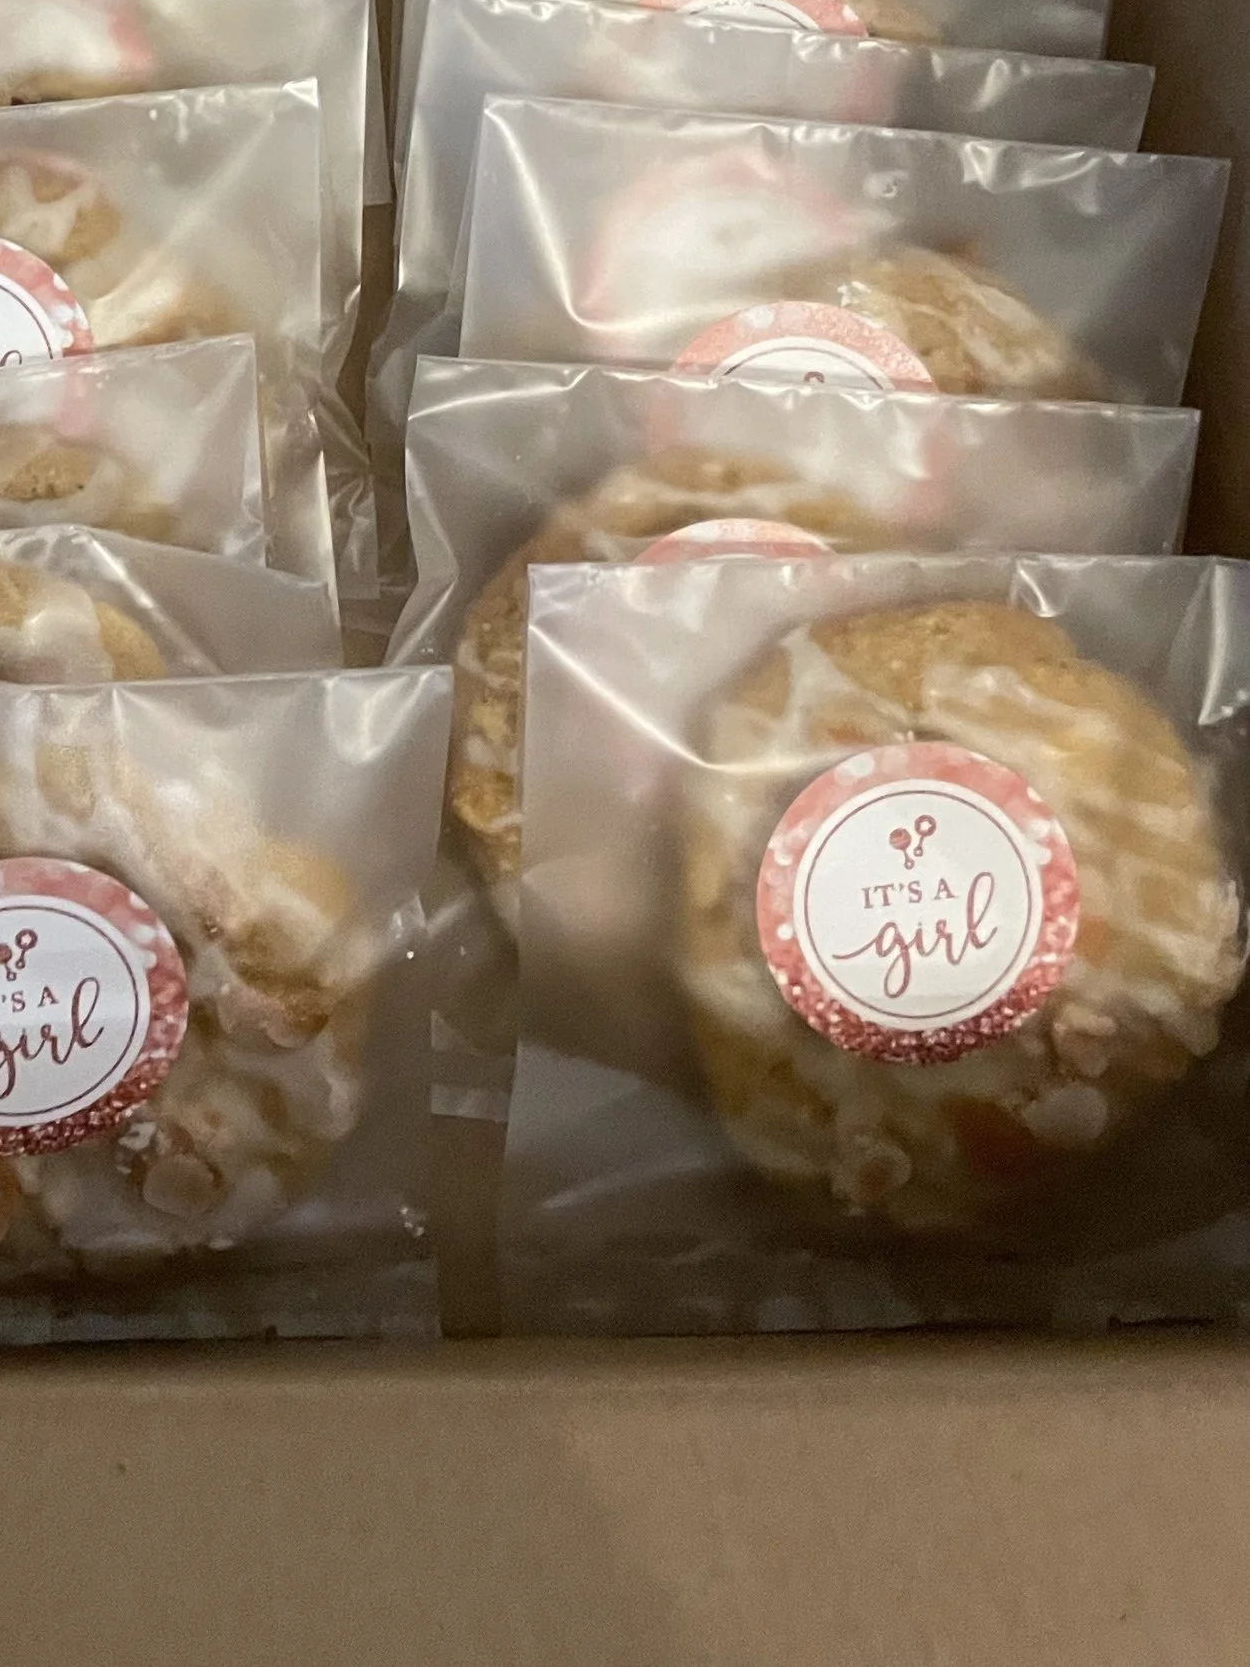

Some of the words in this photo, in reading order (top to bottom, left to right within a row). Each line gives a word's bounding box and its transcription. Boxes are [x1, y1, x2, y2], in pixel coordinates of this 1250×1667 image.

[861, 879, 924, 910] IT'S
[933, 876, 958, 901] A
[832, 871, 998, 999] girl
[37, 985, 60, 1008] A
